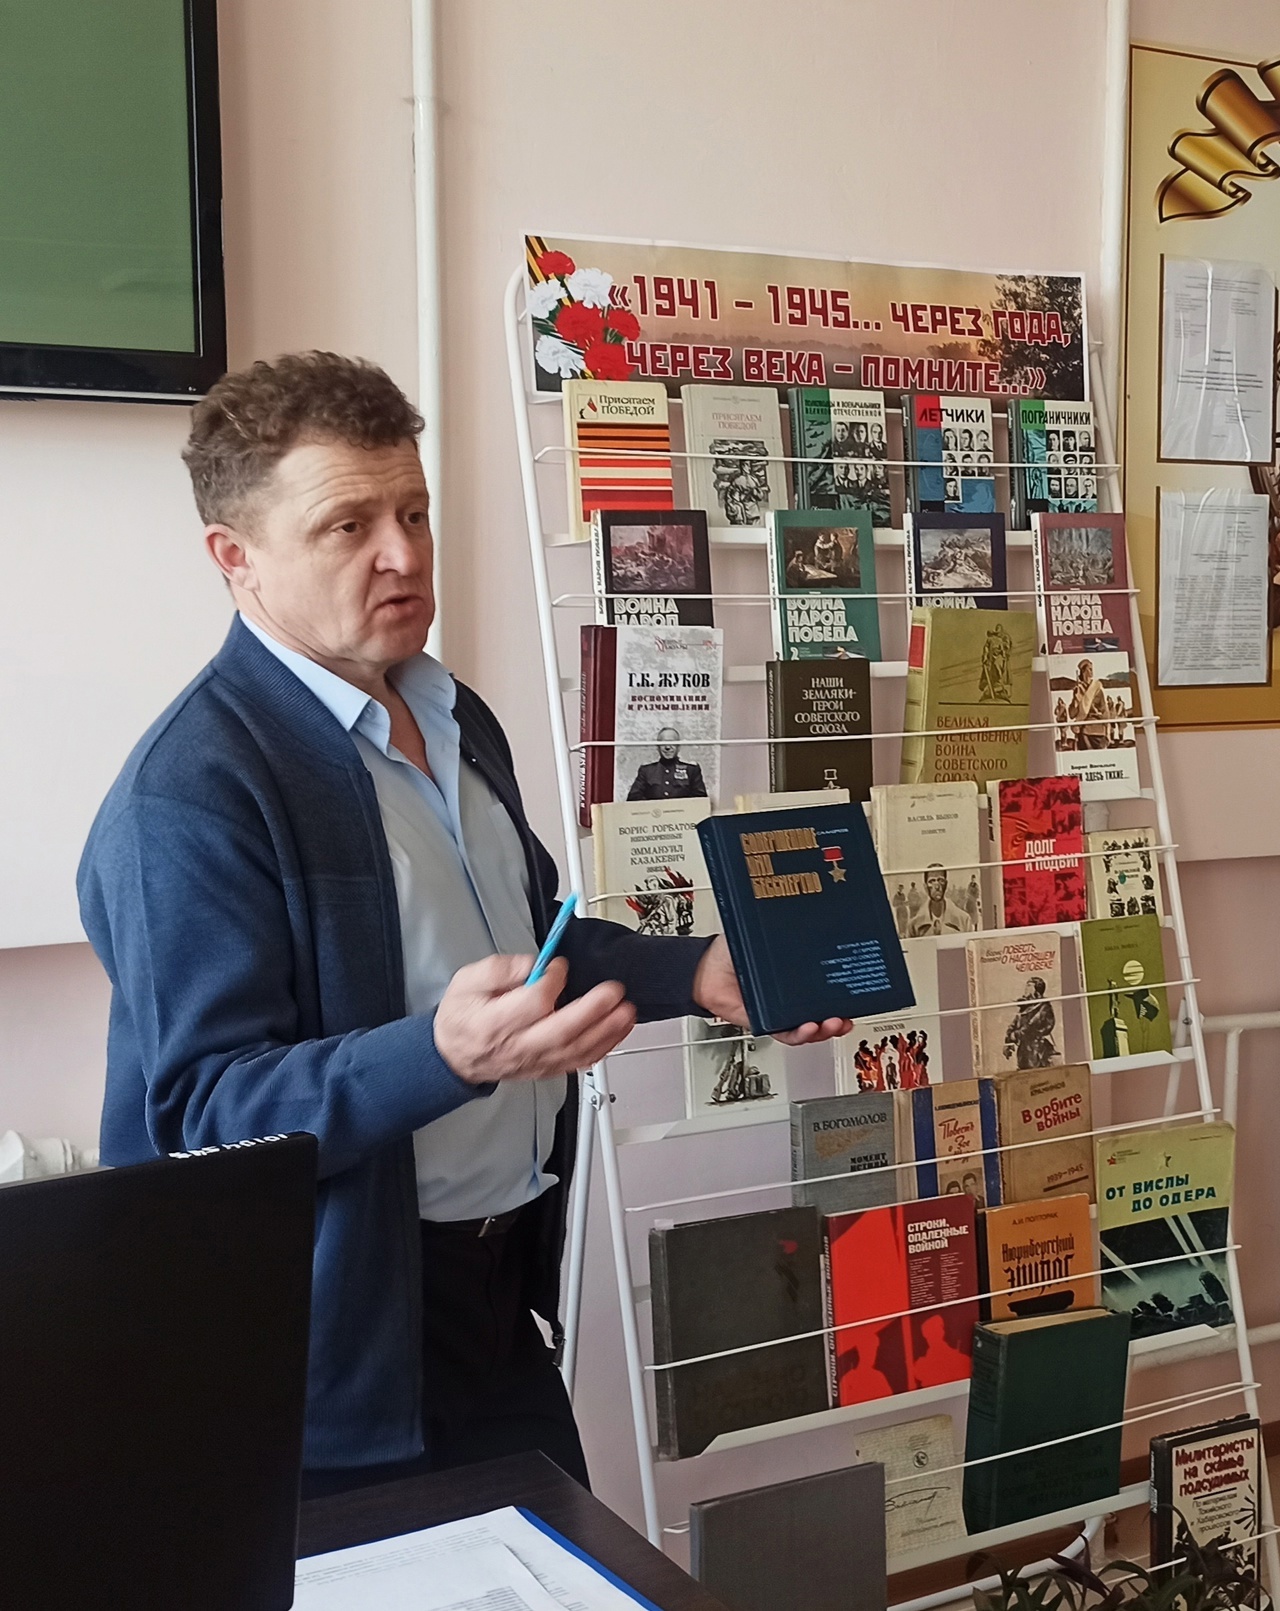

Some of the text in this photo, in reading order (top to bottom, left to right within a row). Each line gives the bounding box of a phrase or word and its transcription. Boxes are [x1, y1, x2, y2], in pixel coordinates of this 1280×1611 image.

[607, 274, 720, 321] «1941
[766, 283, 882, 332] 1945...
[890, 301, 984, 339] ЧЕРЕЗ
[993, 309, 1072, 349] ГОДА,
[625, 341, 732, 382] ЧЕРЕЗ
[742, 347, 826, 386] ВЕКА
[861, 354, 1048, 398] ПОМНИТЕ...»
[599, 395, 656, 408] Присягаем
[601, 404, 655, 417] ПОБЕДОЙ
[919, 408, 985, 424] ЛЕТЧИКИ
[1021, 410, 1092, 426] ПОГРАНИЧНИКИ
[613, 598, 679, 614] ВОЙНА
[786, 597, 846, 611] ВОЙНА
[787, 611, 847, 626] НАРОД
[1051, 605, 1103, 621] НАРОД
[788, 626, 859, 643] ПОБЕДА
[1052, 620, 1113, 637] ПОБЕДА
[790, 646, 799, 661] 2
[1053, 640, 1063, 654] 4
[628, 672, 710, 688] Г.К. ЖУКОВ
[811, 677, 844, 688] НАШИ
[802, 688, 857, 700] ЗЕМЛЯКИ-
[812, 700, 844, 711] ГЕРОИ
[794, 711, 860, 723] СОВЕТСКОГО
[936, 716, 990, 728] ВЕЛИКАЯ
[809, 723, 848, 735] СОЮЗА
[935, 729, 1023, 745] ОТЕЧЕСТВЕННАЯ
[935, 744, 977, 757] ВОЙНА
[934, 758, 1008, 771] СОВЕТСКОГО
[934, 772, 978, 783] СОЮЗА
[618, 822, 696, 835] БОРИС ГОРБАТОВ
[630, 844, 683, 856] ЭММАНУИЛ
[1025, 839, 1056, 858] ДОЛГ
[630, 854, 686, 866] КАЗАКЕВИЧ
[1035, 852, 1080, 872] ПОДВИГ
[1002, 943, 1036, 954] ПОВЕСТЬ
[1001, 950, 1056, 964] О НАСТОЯЩЕМ
[1016, 960, 1054, 972] ЧЕЛОВЕКЕ
[1021, 1093, 1082, 1124] В орбите
[813, 1112, 888, 1133] В.БОГОМОЛОВ
[1036, 1107, 1081, 1132] войны
[850, 1152, 888, 1164] МОМЕНТ
[1106, 1173, 1190, 1200] ОТ ВИСЛЫ
[1131, 1186, 1217, 1213] ДО ОДЕРА
[907, 1225, 970, 1243] ОПАЛЕННЫЕ
[908, 1236, 949, 1254] ВОЙНОЙ
[1175, 1437, 1255, 1467] Милитаристы
[1183, 1454, 1245, 1480] на скамье
[1179, 1468, 1250, 1498] подсудимых
